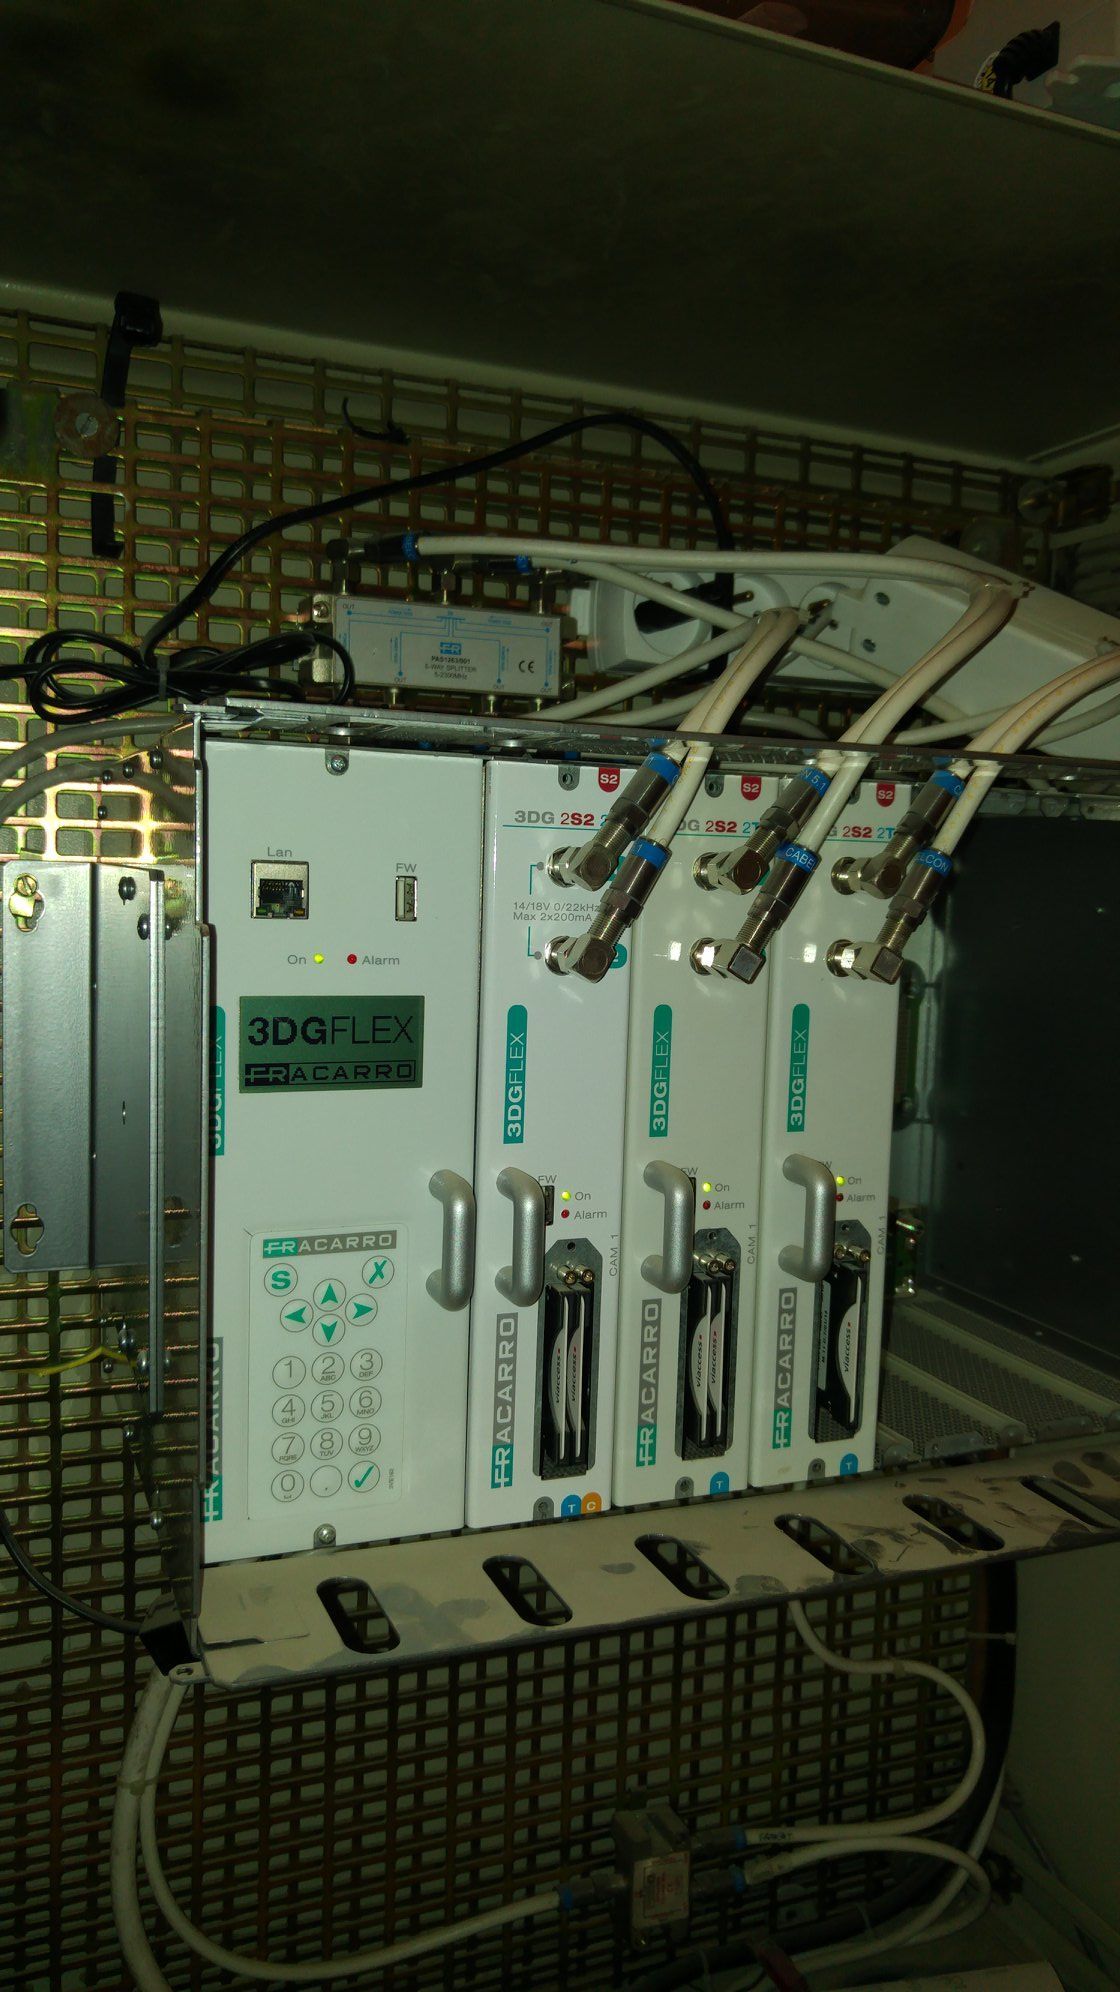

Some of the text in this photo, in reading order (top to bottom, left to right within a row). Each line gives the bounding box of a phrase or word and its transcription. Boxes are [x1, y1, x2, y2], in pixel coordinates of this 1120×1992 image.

[600, 774, 618, 784] S2
[743, 783, 760, 793] S2
[878, 790, 893, 800] S2
[514, 811, 555, 824] 3DG
[560, 812, 595, 826] 2S2
[678, 819, 700, 832] DG
[705, 820, 737, 833] 2S2
[842, 826, 872, 838] 2S2
[267, 847, 292, 857] Lan
[396, 862, 417, 872] FW
[513, 902, 600, 912] 14/18V 0/22kHz
[513, 912, 592, 921] Max 2x200mA
[287, 954, 307, 965] On
[361, 955, 400, 965] Alarm
[248, 1015, 414, 1045] 3DGFLEX
[245, 1063, 413, 1084] FRACARRO
[653, 1031, 670, 1131] 3DGFLEX
[790, 1028, 808, 1126] 3DGFLEX
[507, 1032, 525, 1138] 3DGFLEX
[538, 1175, 557, 1183] FW
[847, 1177, 862, 1185] On
[715, 1183, 730, 1192] On
[575, 1191, 591, 1201] On
[846, 1194, 876, 1202] Alarm
[714, 1201, 745, 1210] Alarm
[574, 1210, 607, 1220] Alarm
[264, 1234, 392, 1254] FRACARRO
[877, 1227, 886, 1254] CAM
[747, 1236, 756, 1264] CAM
[609, 1247, 618, 1277] CAM
[271, 1270, 291, 1290] S
[284, 1360, 293, 1378] 1
[322, 1356, 336, 1374] 2
[360, 1352, 374, 1371] 3
[359, 1370, 374, 1378] DEF
[775, 1292, 795, 1449] FRACARRO
[639, 1303, 659, 1467] FRACARRO
[321, 1394, 335, 1412] 5
[359, 1390, 373, 1408] 6
[494, 1318, 515, 1488] FRACARRO
[281, 1398, 296, 1416] 4
[320, 1431, 334, 1450] 8
[358, 1427, 372, 1445] 9
[282, 1436, 296, 1454] 7
[845, 1461, 853, 1471] T
[281, 1473, 295, 1492] 0
[716, 1480, 723, 1490] T
[567, 1503, 576, 1514] T
[586, 1501, 596, 1511] C
